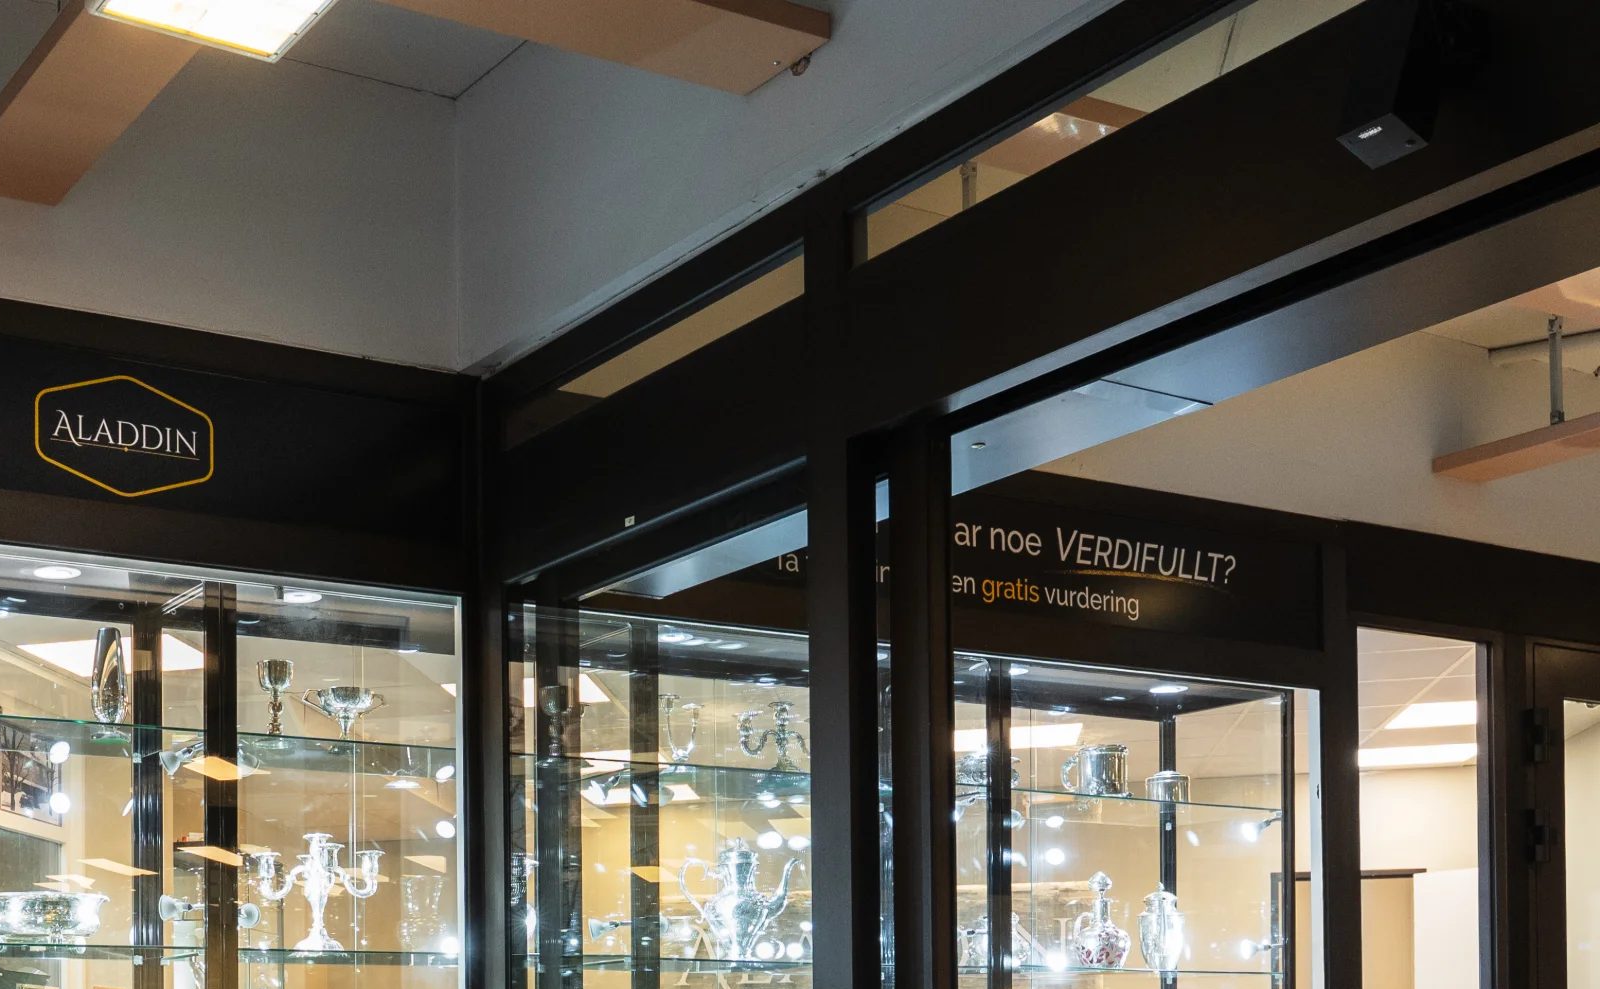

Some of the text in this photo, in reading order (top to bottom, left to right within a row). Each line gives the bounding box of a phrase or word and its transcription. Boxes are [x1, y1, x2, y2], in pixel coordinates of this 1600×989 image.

[51, 408, 199, 456] ALADDIN
[953, 522, 1237, 584] ar noe VERDIFULLT?
[982, 578, 1040, 604] gratis
[1045, 586, 1140, 622] vurdering
